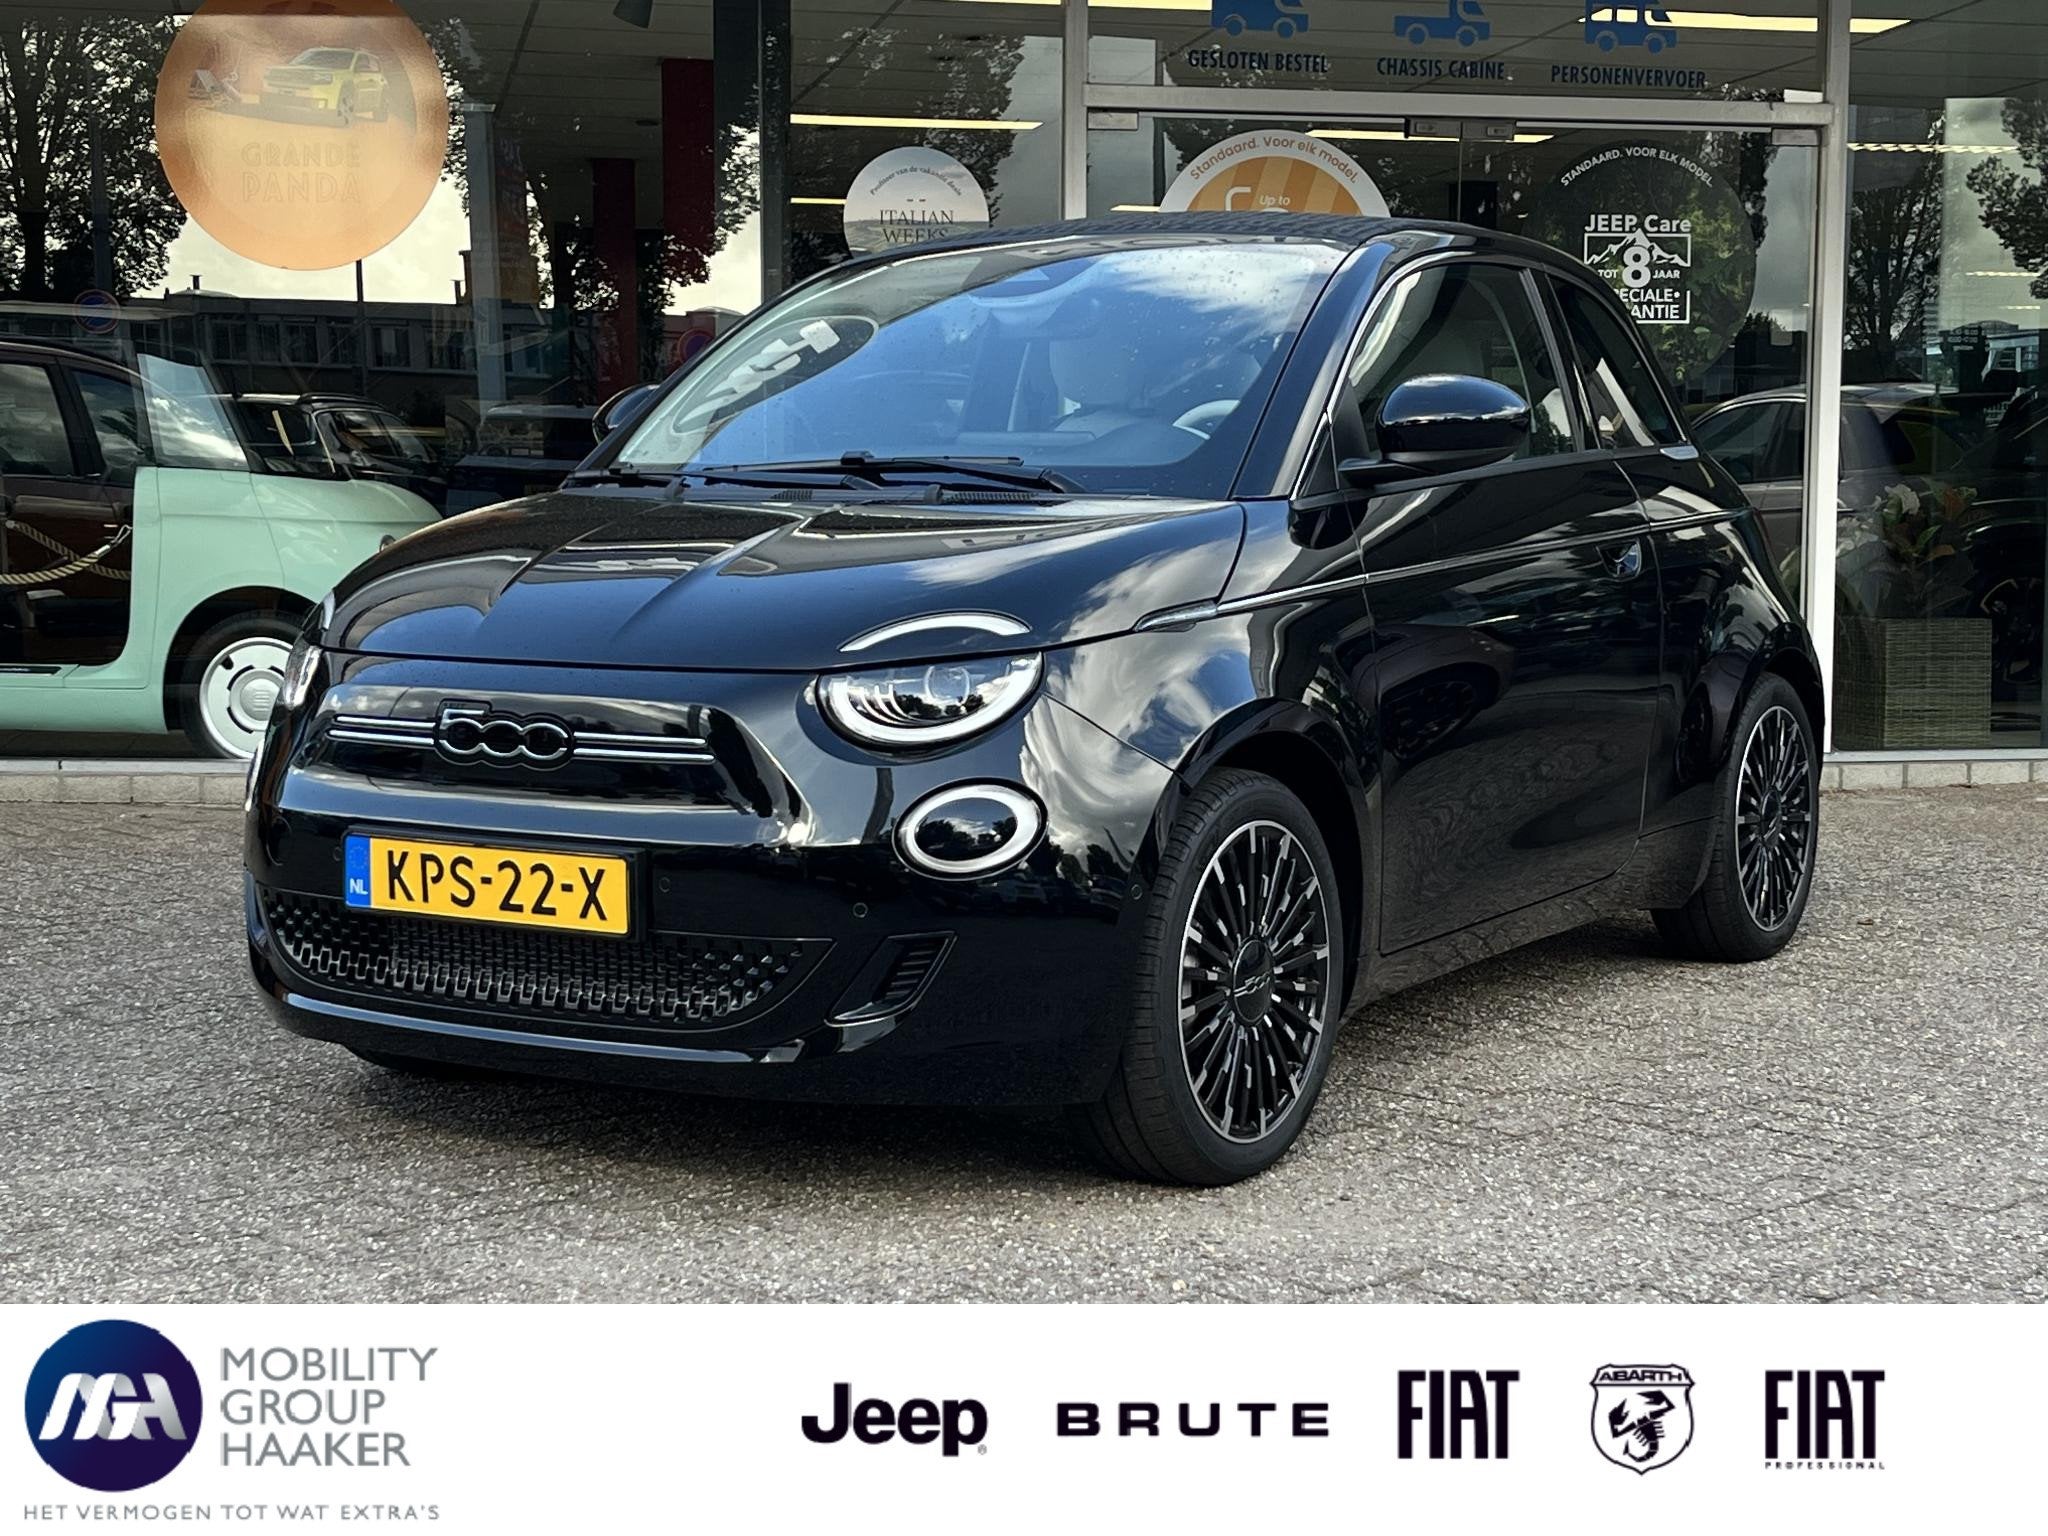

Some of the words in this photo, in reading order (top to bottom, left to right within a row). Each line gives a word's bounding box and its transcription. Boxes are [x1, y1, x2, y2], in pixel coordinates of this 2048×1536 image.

[1188, 49, 1269, 70] GESLOTEN
[1275, 53, 1328, 73] BESTEL
[1377, 56, 1442, 77] CHASSIS
[1448, 59, 1505, 80] CABINE
[1551, 64, 1706, 89] PERSONENVERVOER
[241, 142, 360, 167] GRANDE
[1263, 135, 1293, 148] Voor
[1297, 140, 1317, 156] elk
[1318, 149, 1359, 184] model.
[1625, 146, 1657, 158] VOOR
[1658, 150, 1679, 164] ELK
[1678, 157, 1713, 188] MODEL
[242, 172, 361, 203] PANDA
[1259, 195, 1276, 207] Up
[1277, 194, 1291, 206] to
[879, 209, 955, 225] ITALIAN
[1643, 214, 1692, 233] Care
[882, 228, 949, 243] WEEKS
[1597, 269, 1619, 279] TOT
[1621, 245, 1652, 289] 8
[1652, 269, 1681, 279] JAAR
[1630, 304, 1681, 319] ANTIE
[440, 708, 569, 760] 500
[349, 877, 368, 895] NL
[386, 849, 608, 921] KPS-22-X
